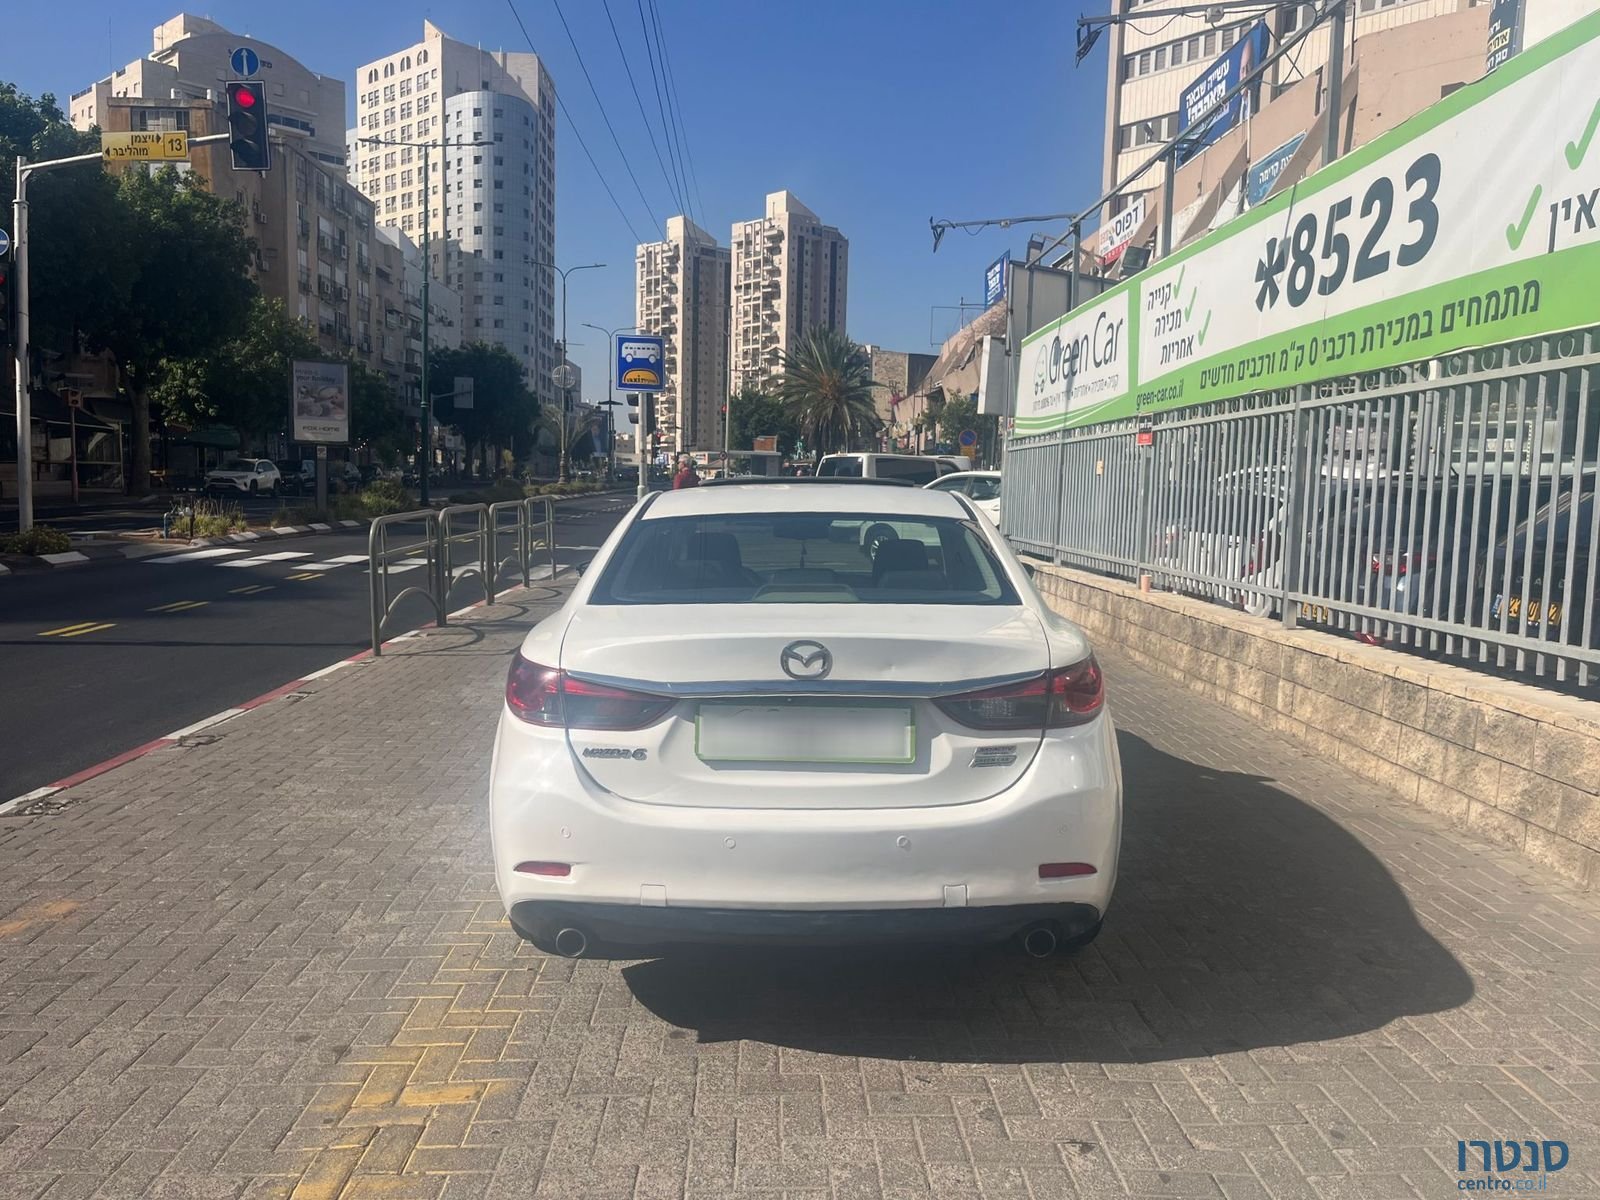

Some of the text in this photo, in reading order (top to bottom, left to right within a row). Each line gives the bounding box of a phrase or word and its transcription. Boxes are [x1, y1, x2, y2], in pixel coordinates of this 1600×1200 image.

[1186, 80, 1206, 109] שבאה
[113, 145, 149, 156] מוהליבר
[131, 133, 155, 145] ויצמן
[168, 138, 183, 152] 13
[1115, 206, 1139, 237] דפוס
[1548, 187, 1600, 254] אין
[1148, 282, 1171, 311] קנייה
[1440, 279, 1541, 332] מתמחים
[1154, 308, 1182, 338] מכירה
[1360, 309, 1433, 354] במכירת
[1048, 311, 1124, 385] Green Car
[1160, 334, 1195, 366] אחריות
[1308, 336, 1319, 366] 0
[1322, 331, 1356, 362] רכבי
[1200, 362, 1235, 390] חדשים
[1237, 351, 1276, 382] ורכבים
[1136, 378, 1184, 411] green-car.co.il
